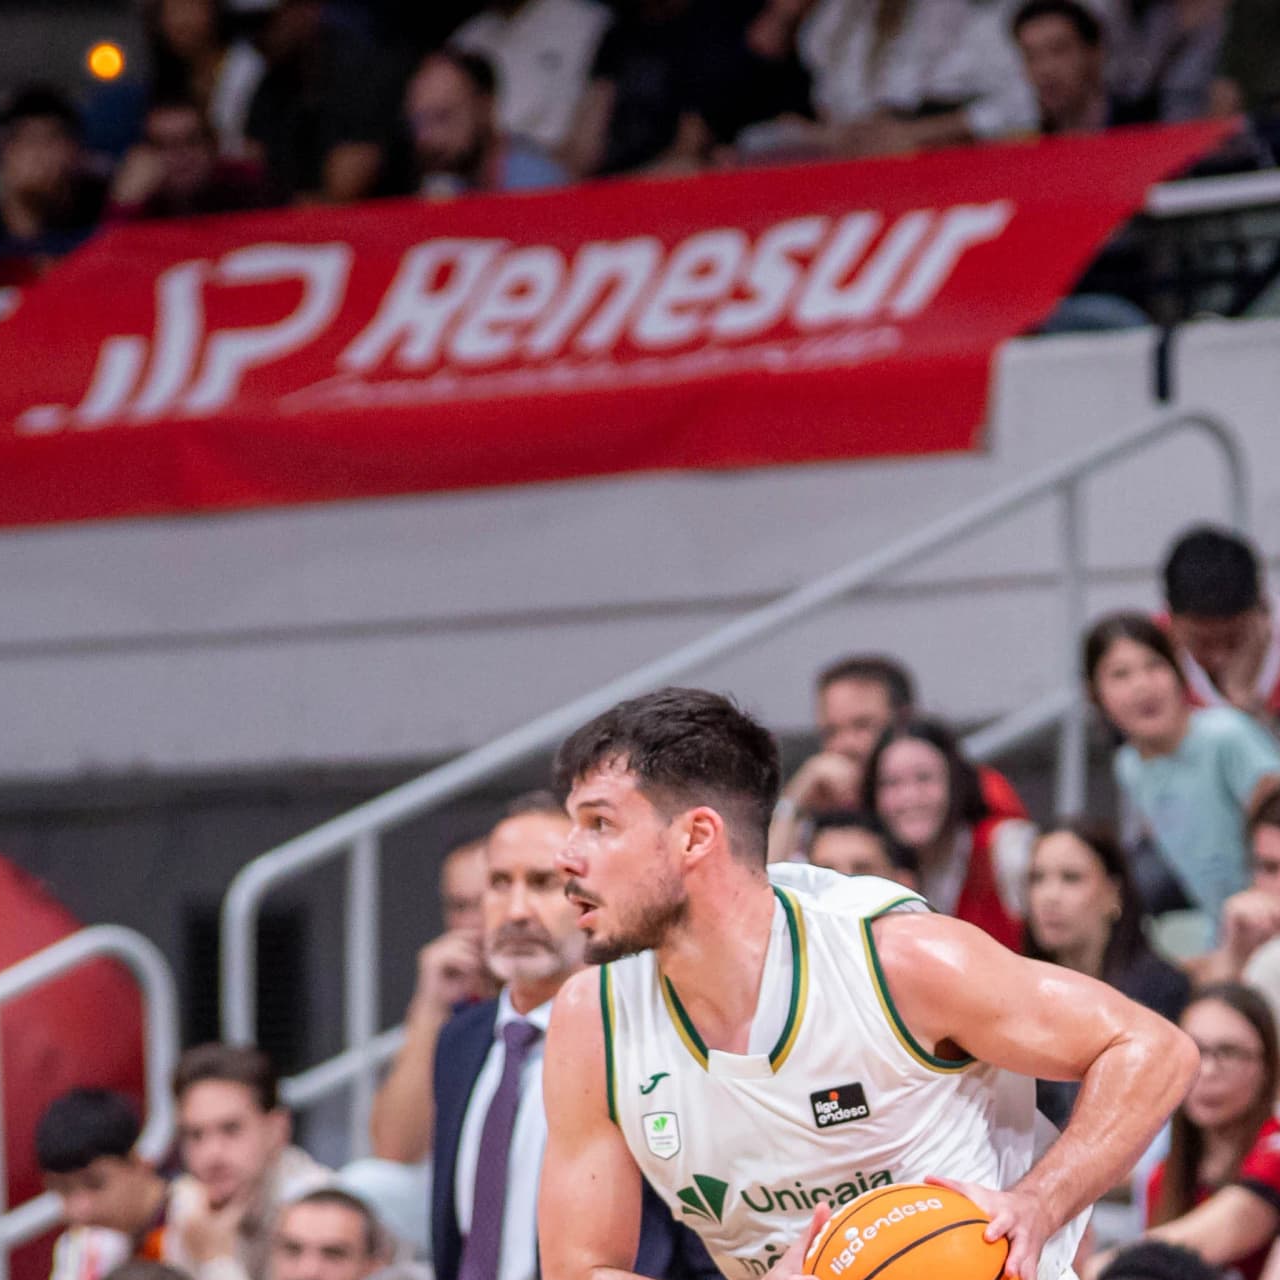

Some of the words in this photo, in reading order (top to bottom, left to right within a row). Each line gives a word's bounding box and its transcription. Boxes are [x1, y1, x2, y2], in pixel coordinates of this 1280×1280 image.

[336, 200, 1016, 378] Renesur
[815, 1100, 839, 1114] liga
[818, 1105, 868, 1125] endesa
[830, 1237, 865, 1275] liga
[863, 1197, 944, 1240] endesa
